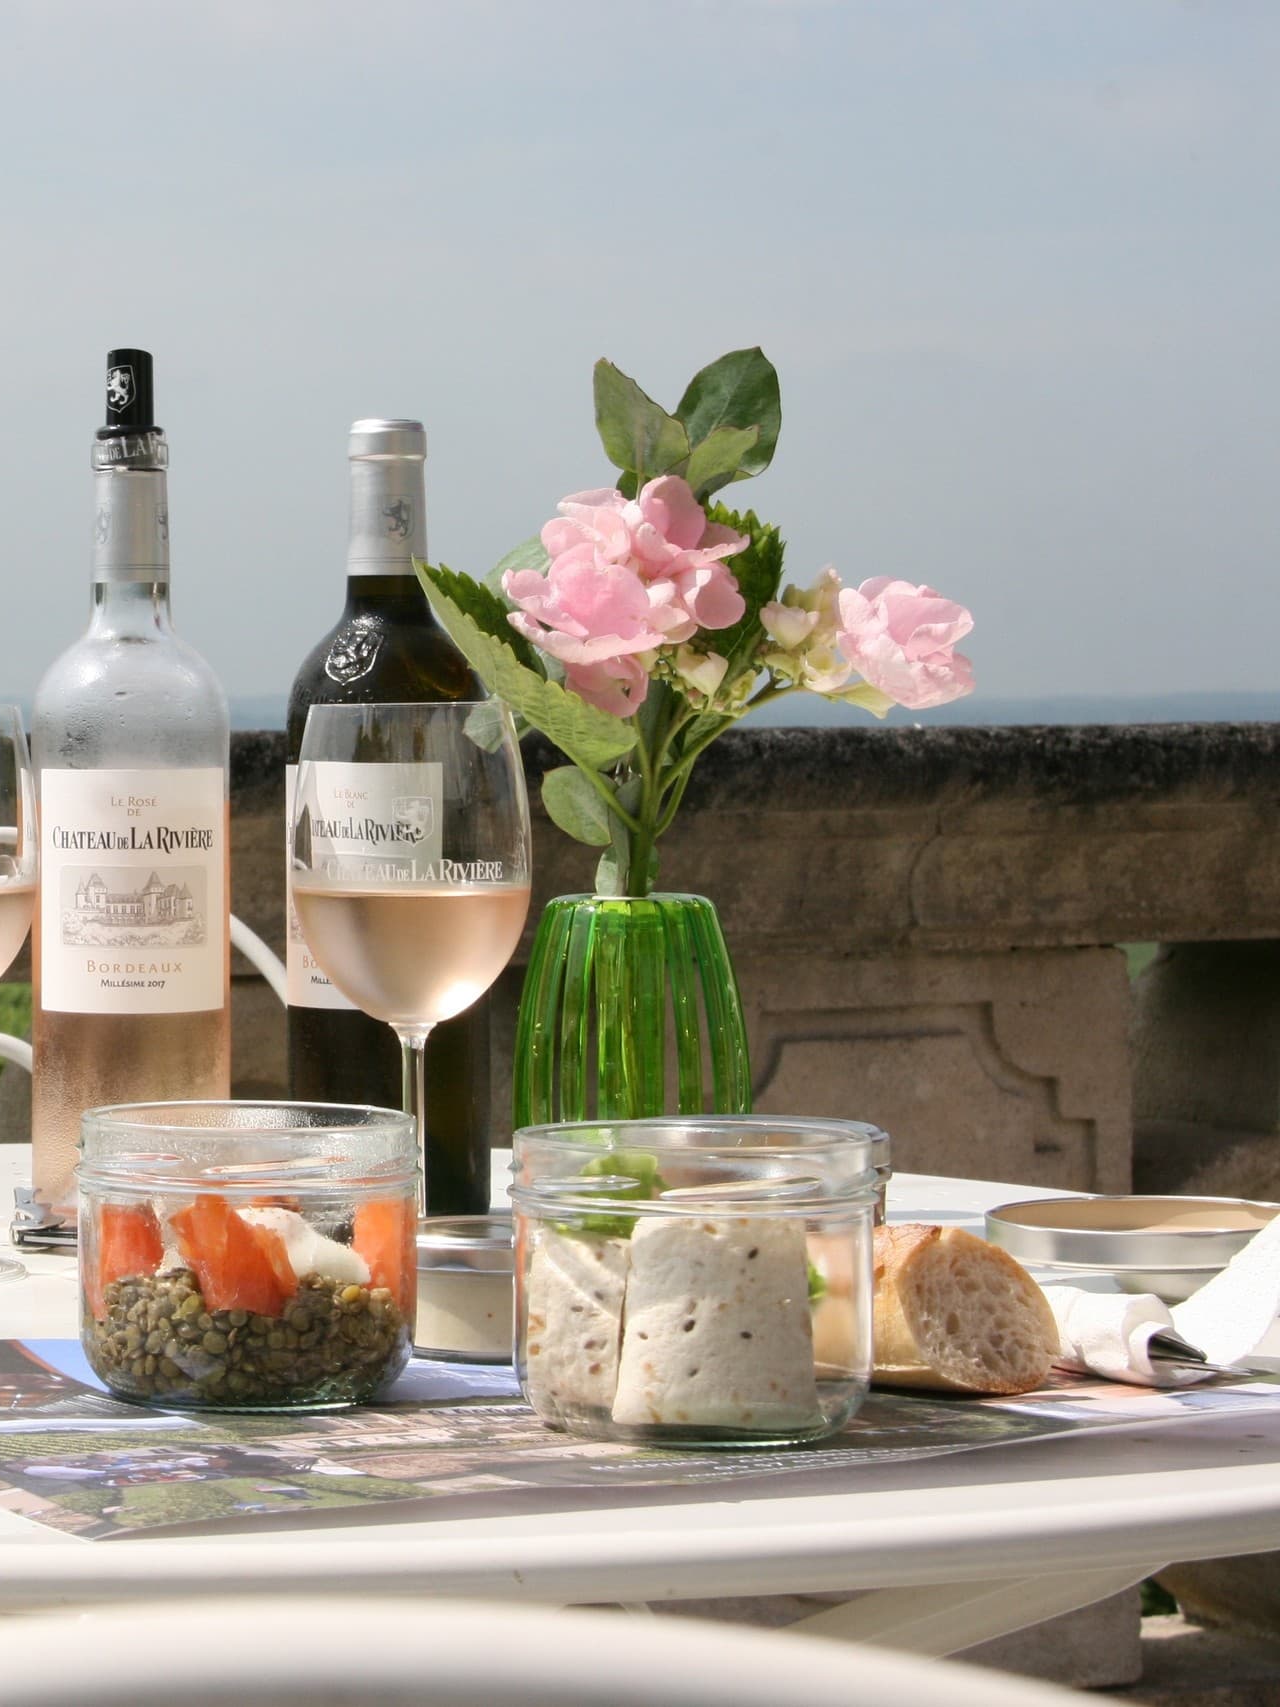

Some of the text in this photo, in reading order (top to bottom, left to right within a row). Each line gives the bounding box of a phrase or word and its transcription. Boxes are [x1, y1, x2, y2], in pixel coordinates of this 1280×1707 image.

[110, 796, 124, 807] LE
[126, 808, 142, 817] DE
[52, 825, 116, 850] CHATEAU
[156, 826, 213, 854] RIVIÈRE
[326, 862, 396, 881] CHTEAU
[439, 858, 503, 885] RIVIÈRE
[86, 959, 183, 975] BORDEAUX
[100, 977, 166, 989] MILLÉSIME 2017
